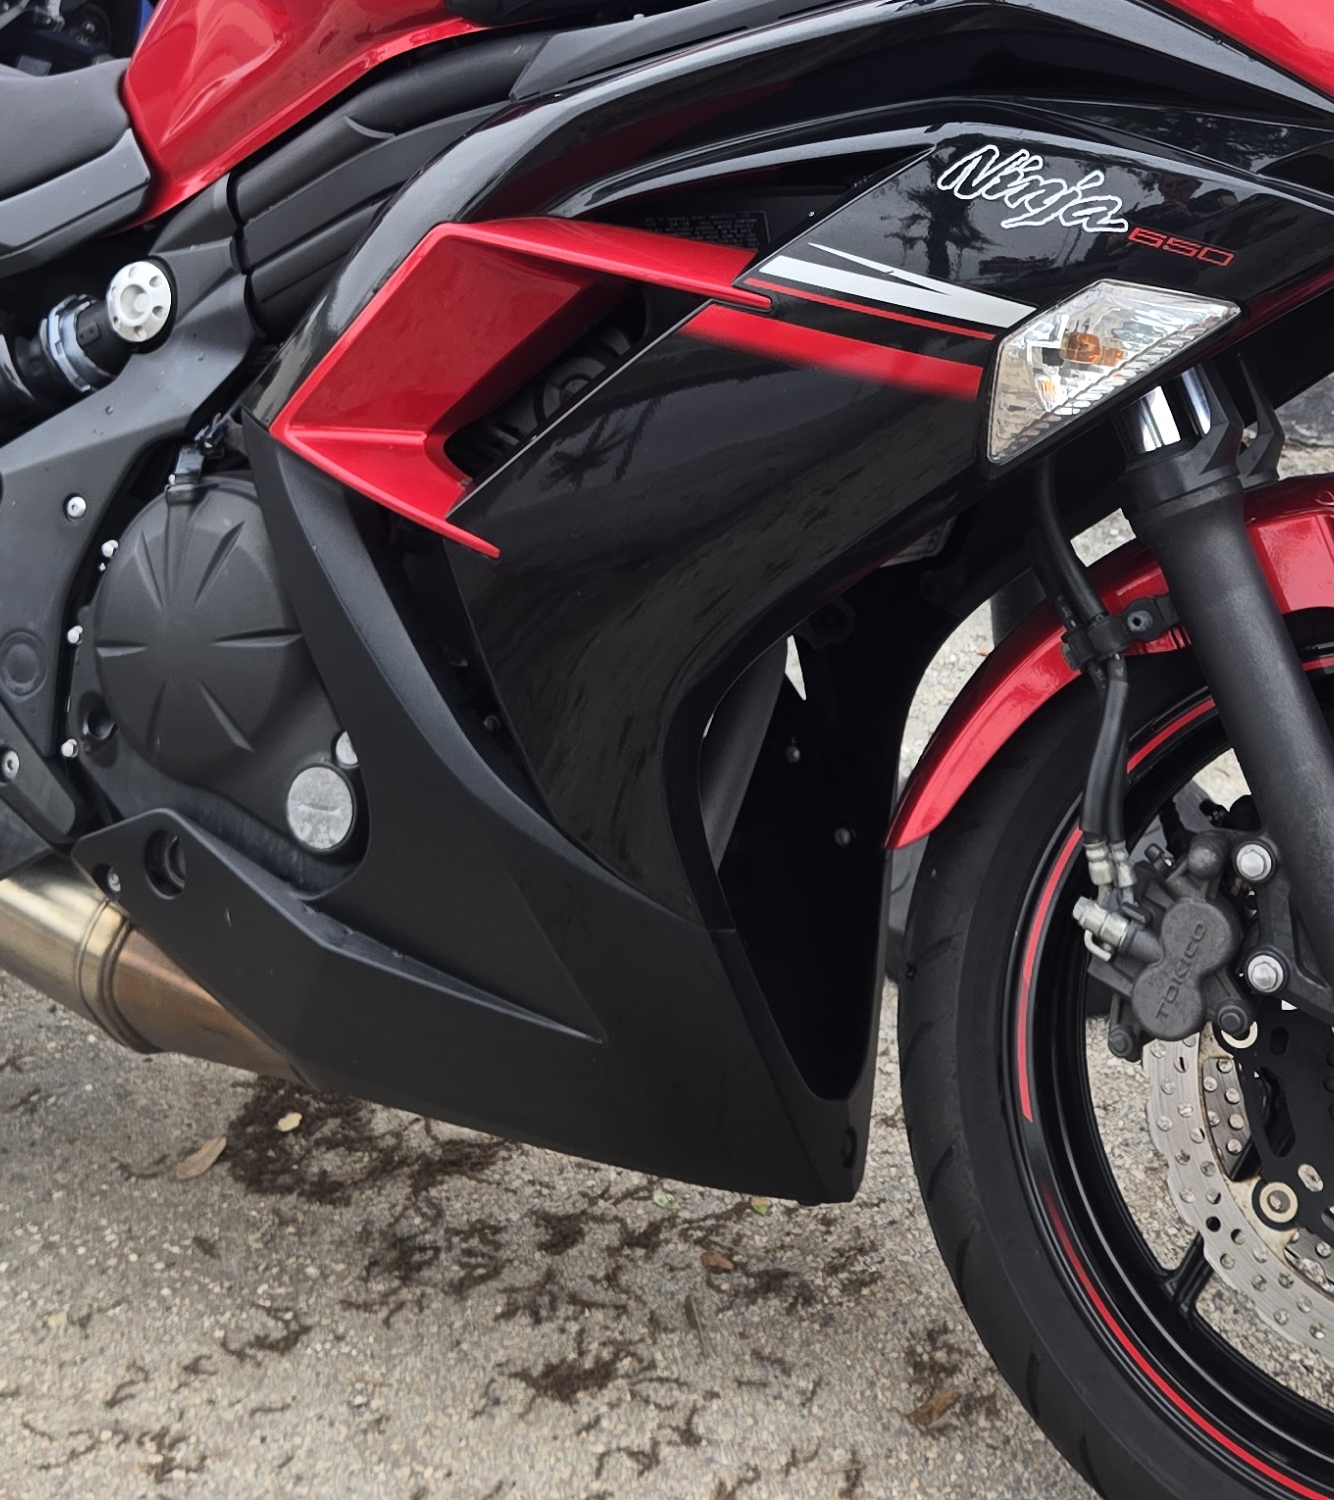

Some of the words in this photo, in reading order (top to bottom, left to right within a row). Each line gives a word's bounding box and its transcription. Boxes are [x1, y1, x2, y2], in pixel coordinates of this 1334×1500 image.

[936, 144, 1129, 233] Ninja
[1127, 226, 1237, 268] 650
[1154, 921, 1207, 1019] TOKICO
